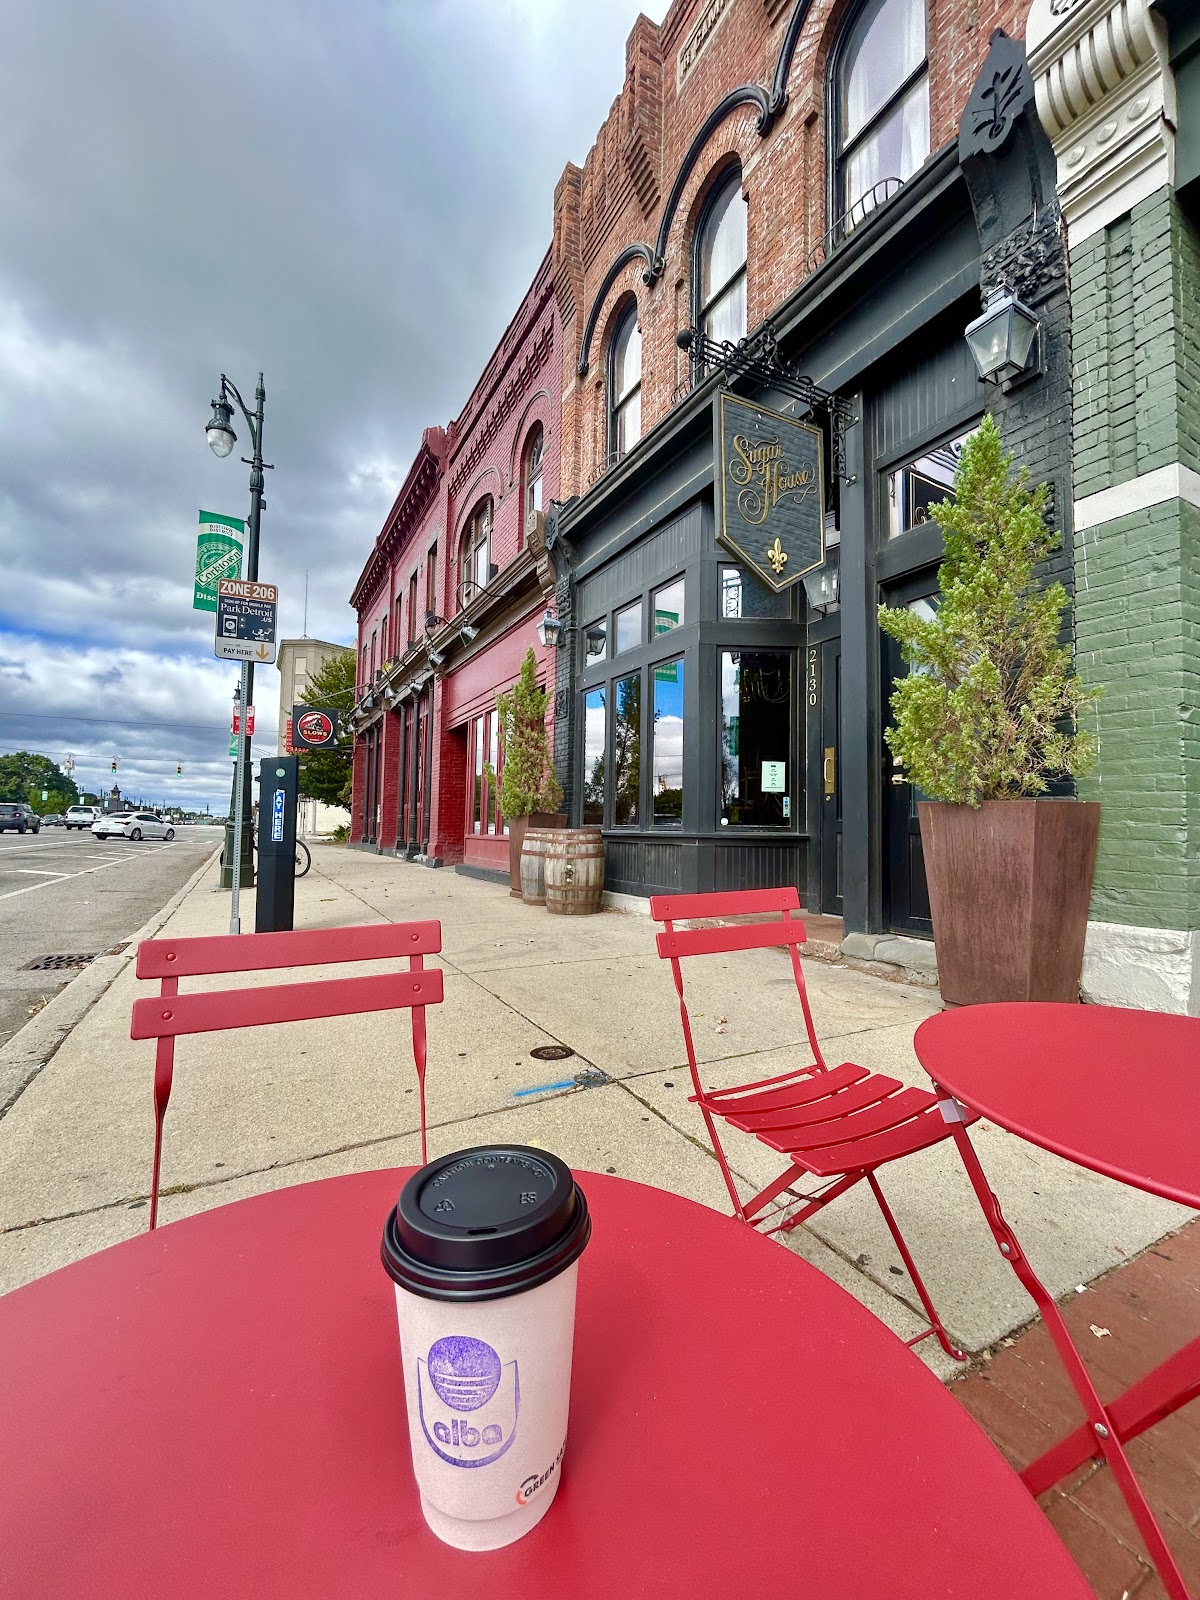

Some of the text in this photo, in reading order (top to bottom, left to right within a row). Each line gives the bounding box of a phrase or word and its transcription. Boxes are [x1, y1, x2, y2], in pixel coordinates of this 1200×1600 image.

[729, 434, 785, 485] Sugar
[737, 460, 817, 525] House
[198, 551, 241, 584] Corktown
[220, 581, 251, 597] ZONE
[252, 585, 275, 600] 206
[242, 604, 273, 618] Detroit
[809, 649, 818, 706] 2130
[303, 729, 328, 737] SLOWS
[273, 811, 283, 839] HERE
[433, 1418, 503, 1447] alba
[524, 1462, 555, 1497] GREEN
